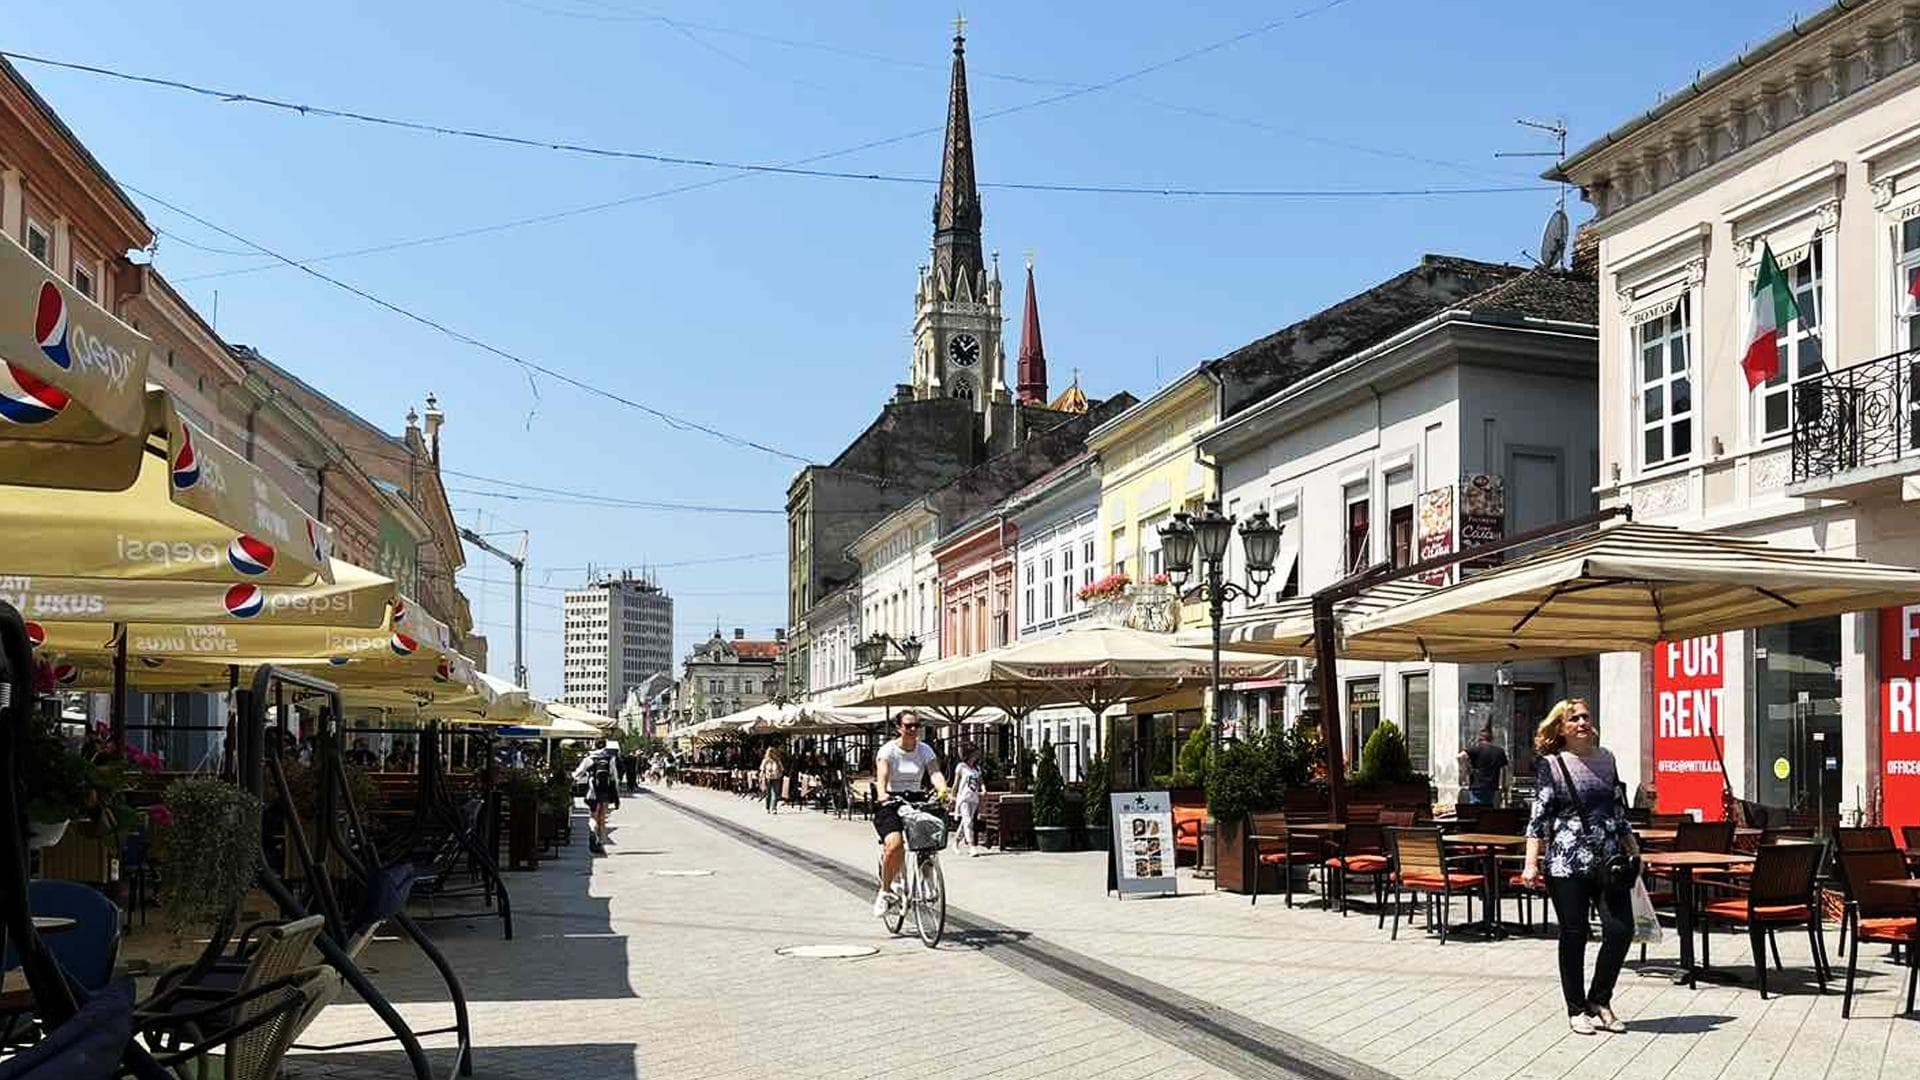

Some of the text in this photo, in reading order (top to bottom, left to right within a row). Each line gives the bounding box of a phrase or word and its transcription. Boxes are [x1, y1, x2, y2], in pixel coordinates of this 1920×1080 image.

[1634, 302, 1675, 324] BOMAR
[0, 576, 31, 591] ATI
[34, 594, 106, 613] UKUS
[270, 593, 354, 616] pepsi
[1667, 634, 1719, 678] FOR
[1659, 687, 1727, 737] RENT
